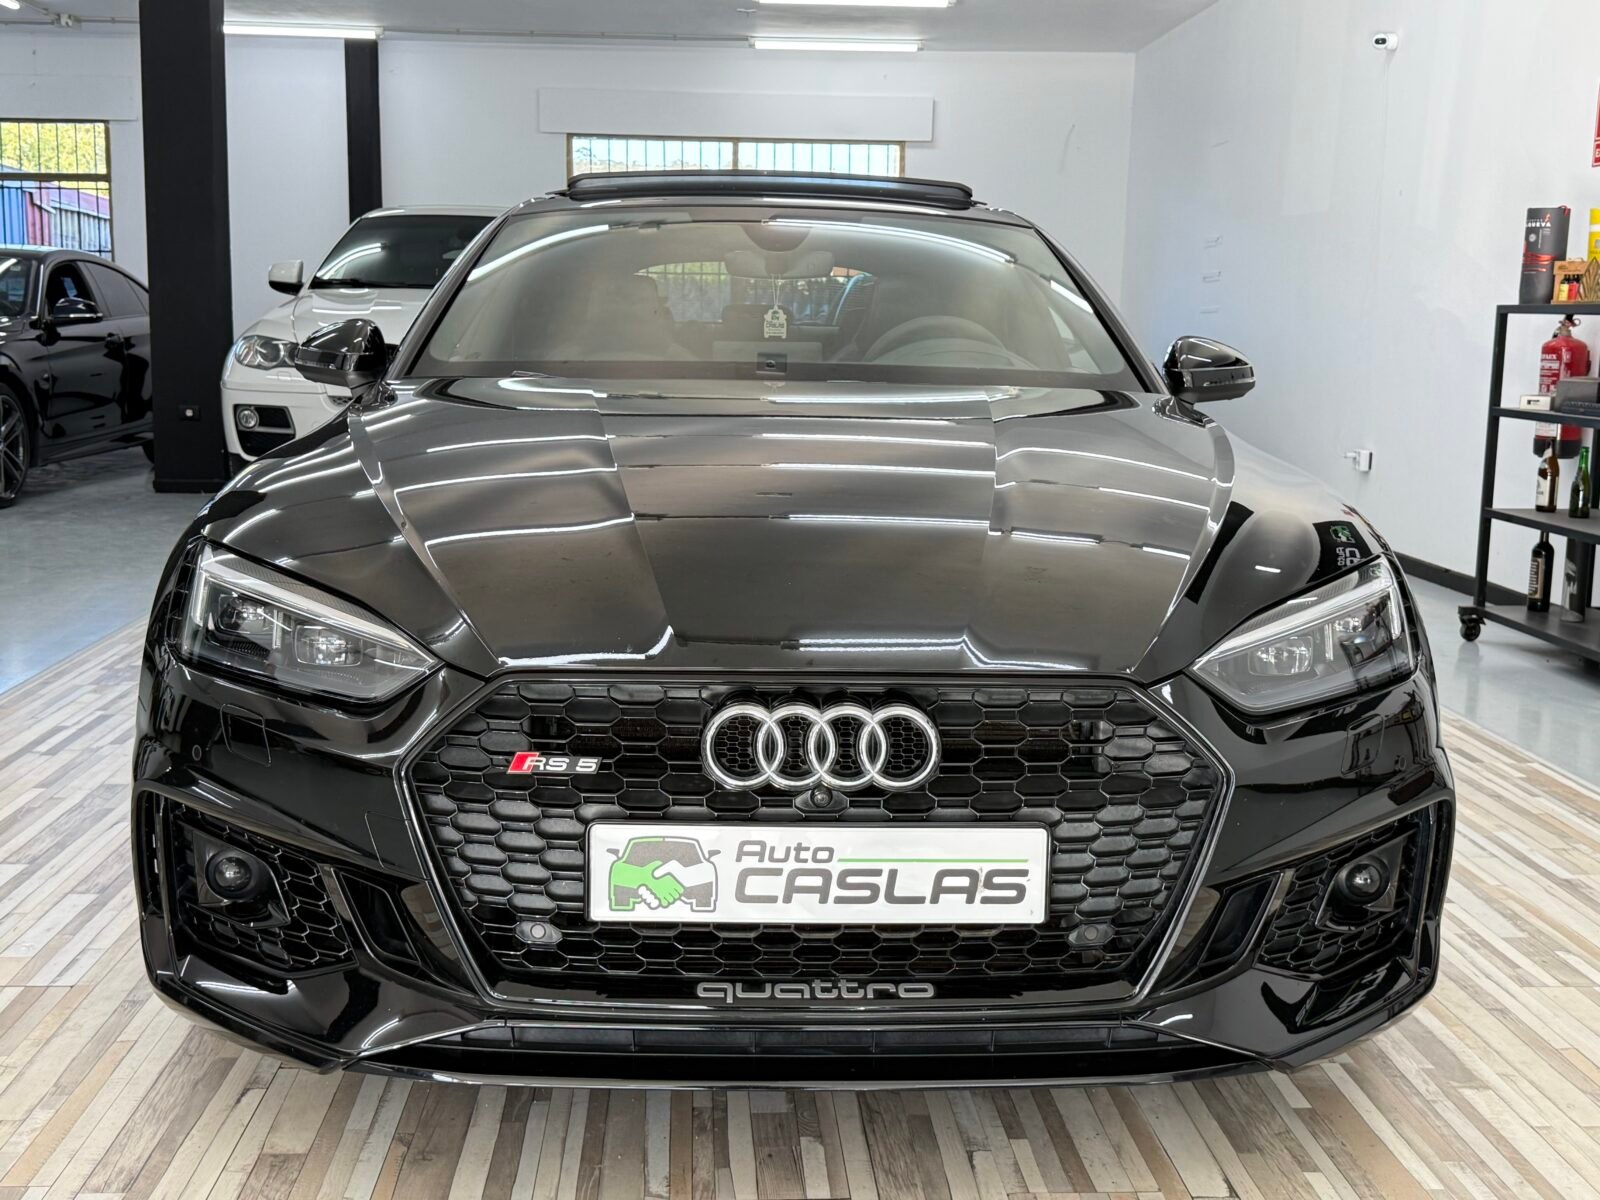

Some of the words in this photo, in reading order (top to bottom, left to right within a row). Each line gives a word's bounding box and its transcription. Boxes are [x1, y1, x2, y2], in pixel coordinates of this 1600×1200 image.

[522, 757, 569, 771] RS
[576, 758, 598, 772] 5
[735, 839, 835, 864] Auto
[734, 867, 1029, 905] CASLAS
[697, 979, 935, 1003] quattro
